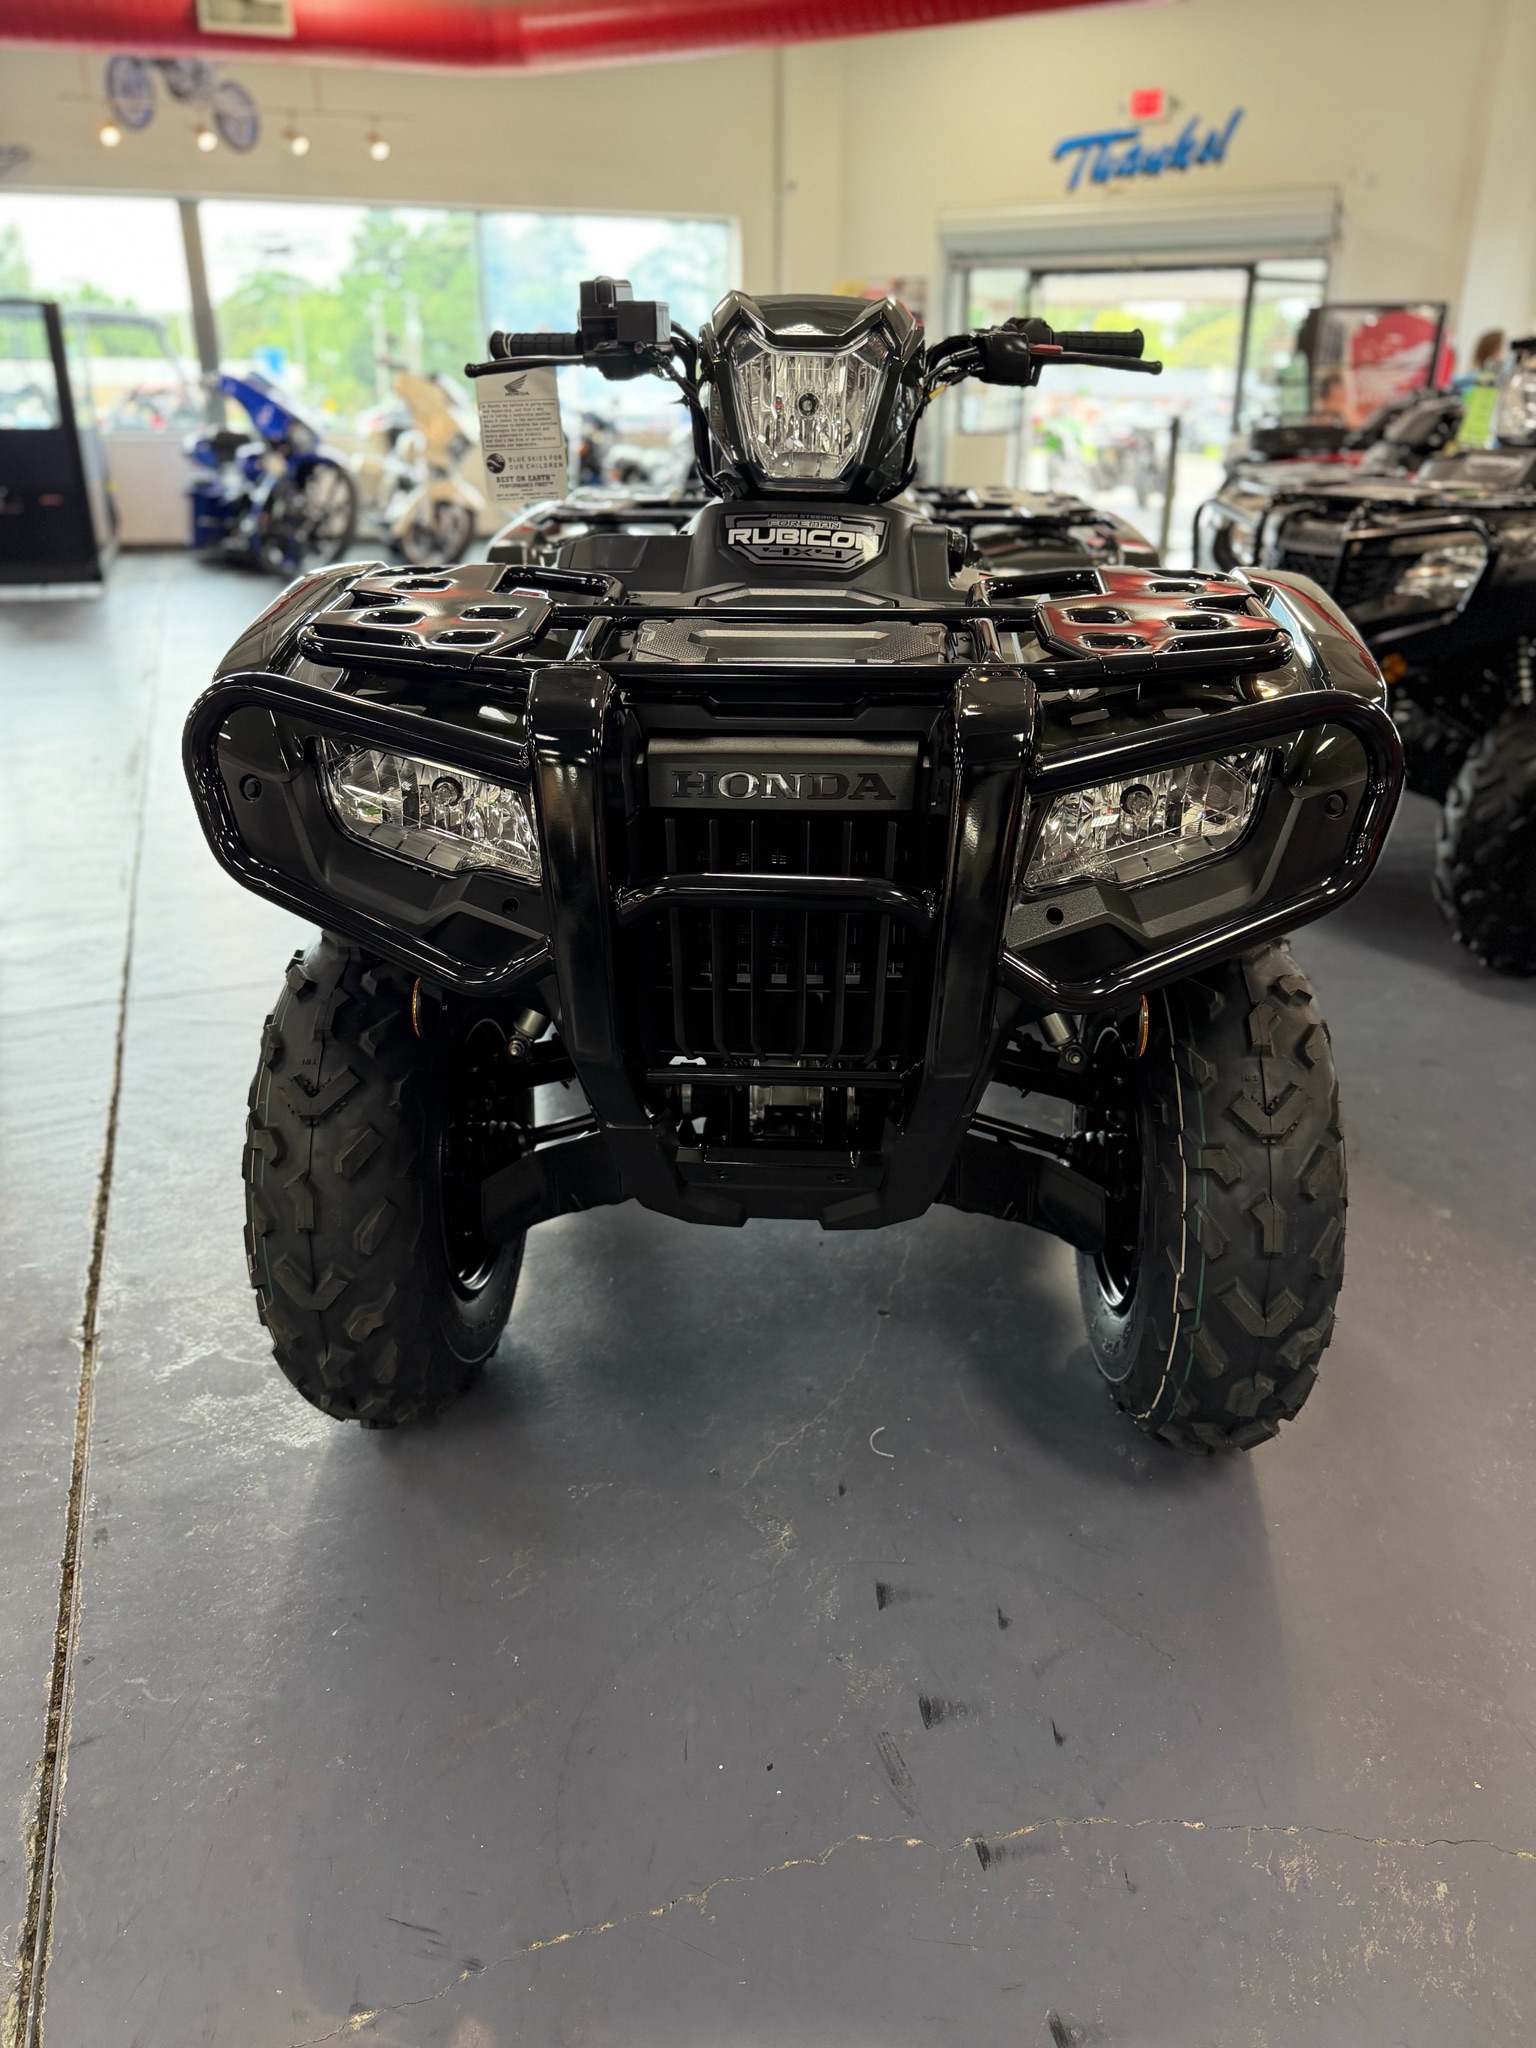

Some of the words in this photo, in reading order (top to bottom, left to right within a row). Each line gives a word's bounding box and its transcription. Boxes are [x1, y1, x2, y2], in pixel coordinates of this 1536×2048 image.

[496, 476, 514, 484] BEST
[767, 519, 841, 529] FOREMAN
[728, 528, 880, 552] RUBICON
[671, 770, 896, 800] HONDA
